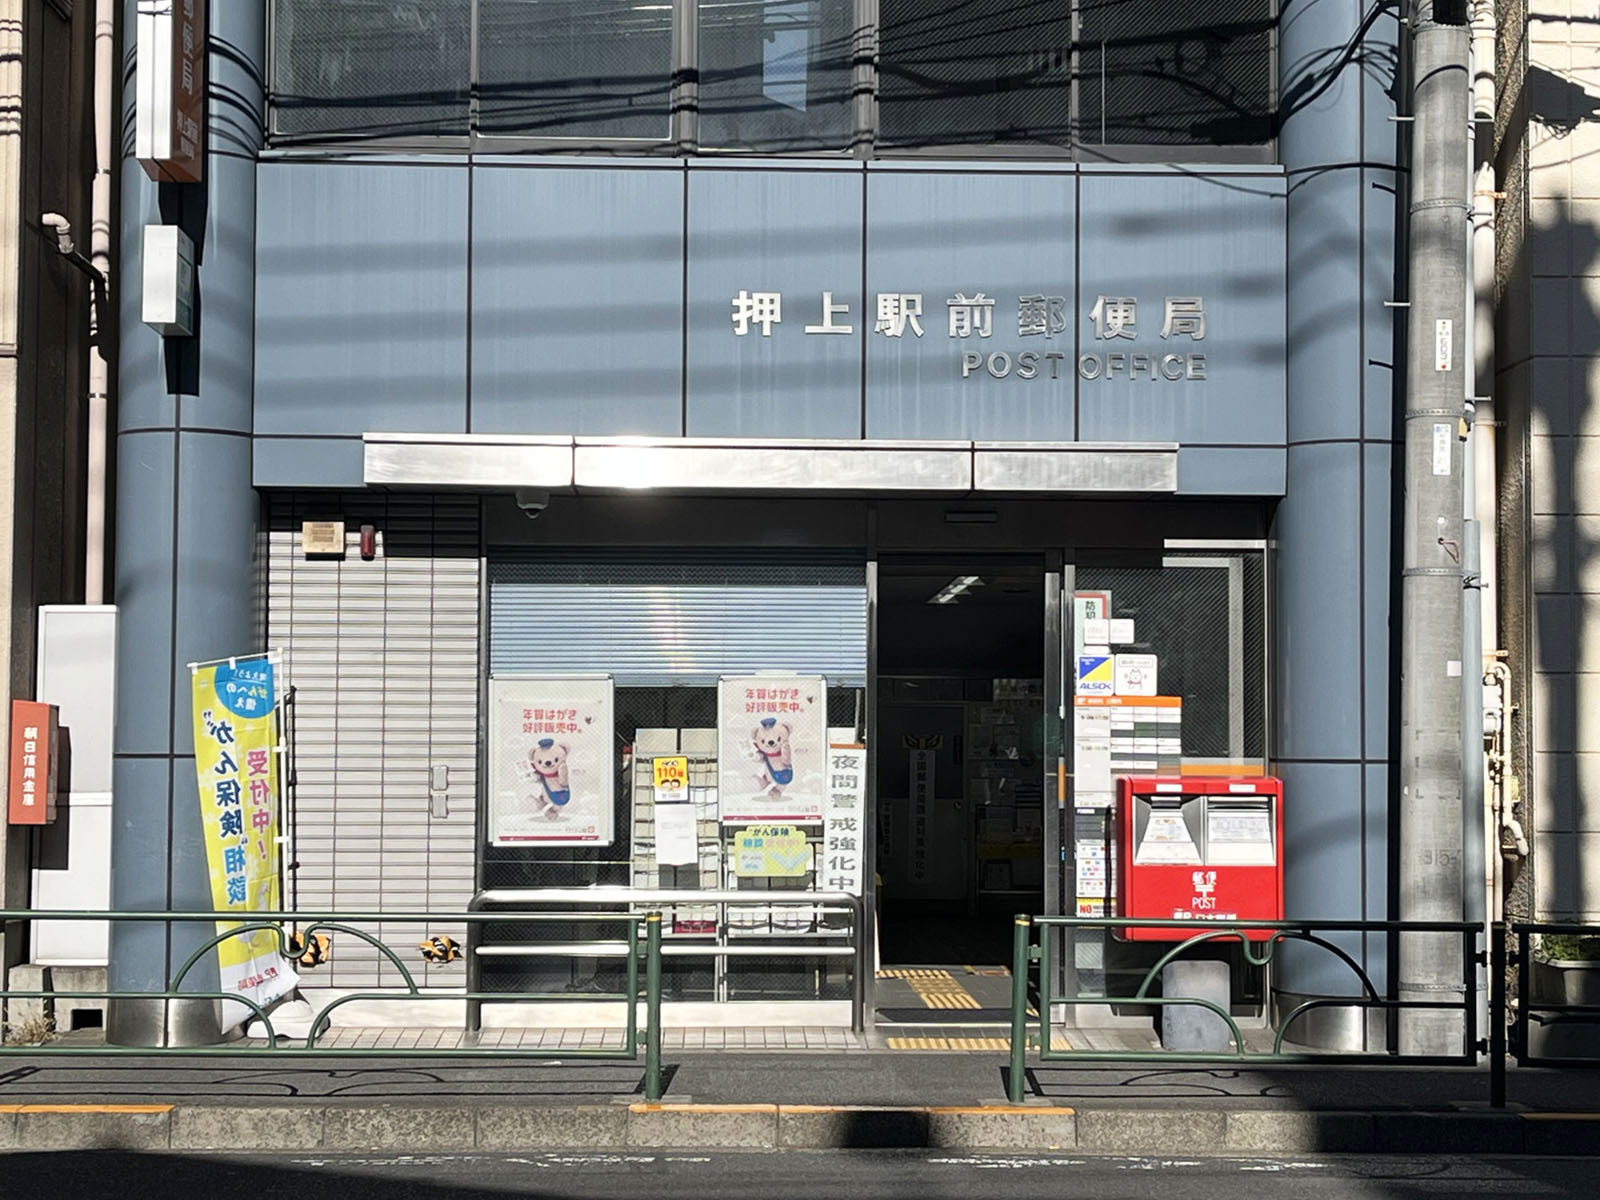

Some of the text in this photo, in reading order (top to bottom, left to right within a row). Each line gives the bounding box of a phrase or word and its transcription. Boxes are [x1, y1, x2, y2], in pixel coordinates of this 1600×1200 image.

[732, 290, 1207, 341] 押上駅前郵便局
[962, 350, 1207, 381] POST OFFICE
[1080, 682, 1112, 690] ALSOK
[745, 688, 800, 699] 年賀はがき
[745, 702, 805, 713] 好評販売中。
[522, 709, 577, 721] 年賀はがき
[522, 722, 583, 734] 好評販売中。
[828, 755, 859, 890] 夜間警戒強化中
[1080, 904, 1092, 914] NO
[1192, 897, 1217, 909] POST
